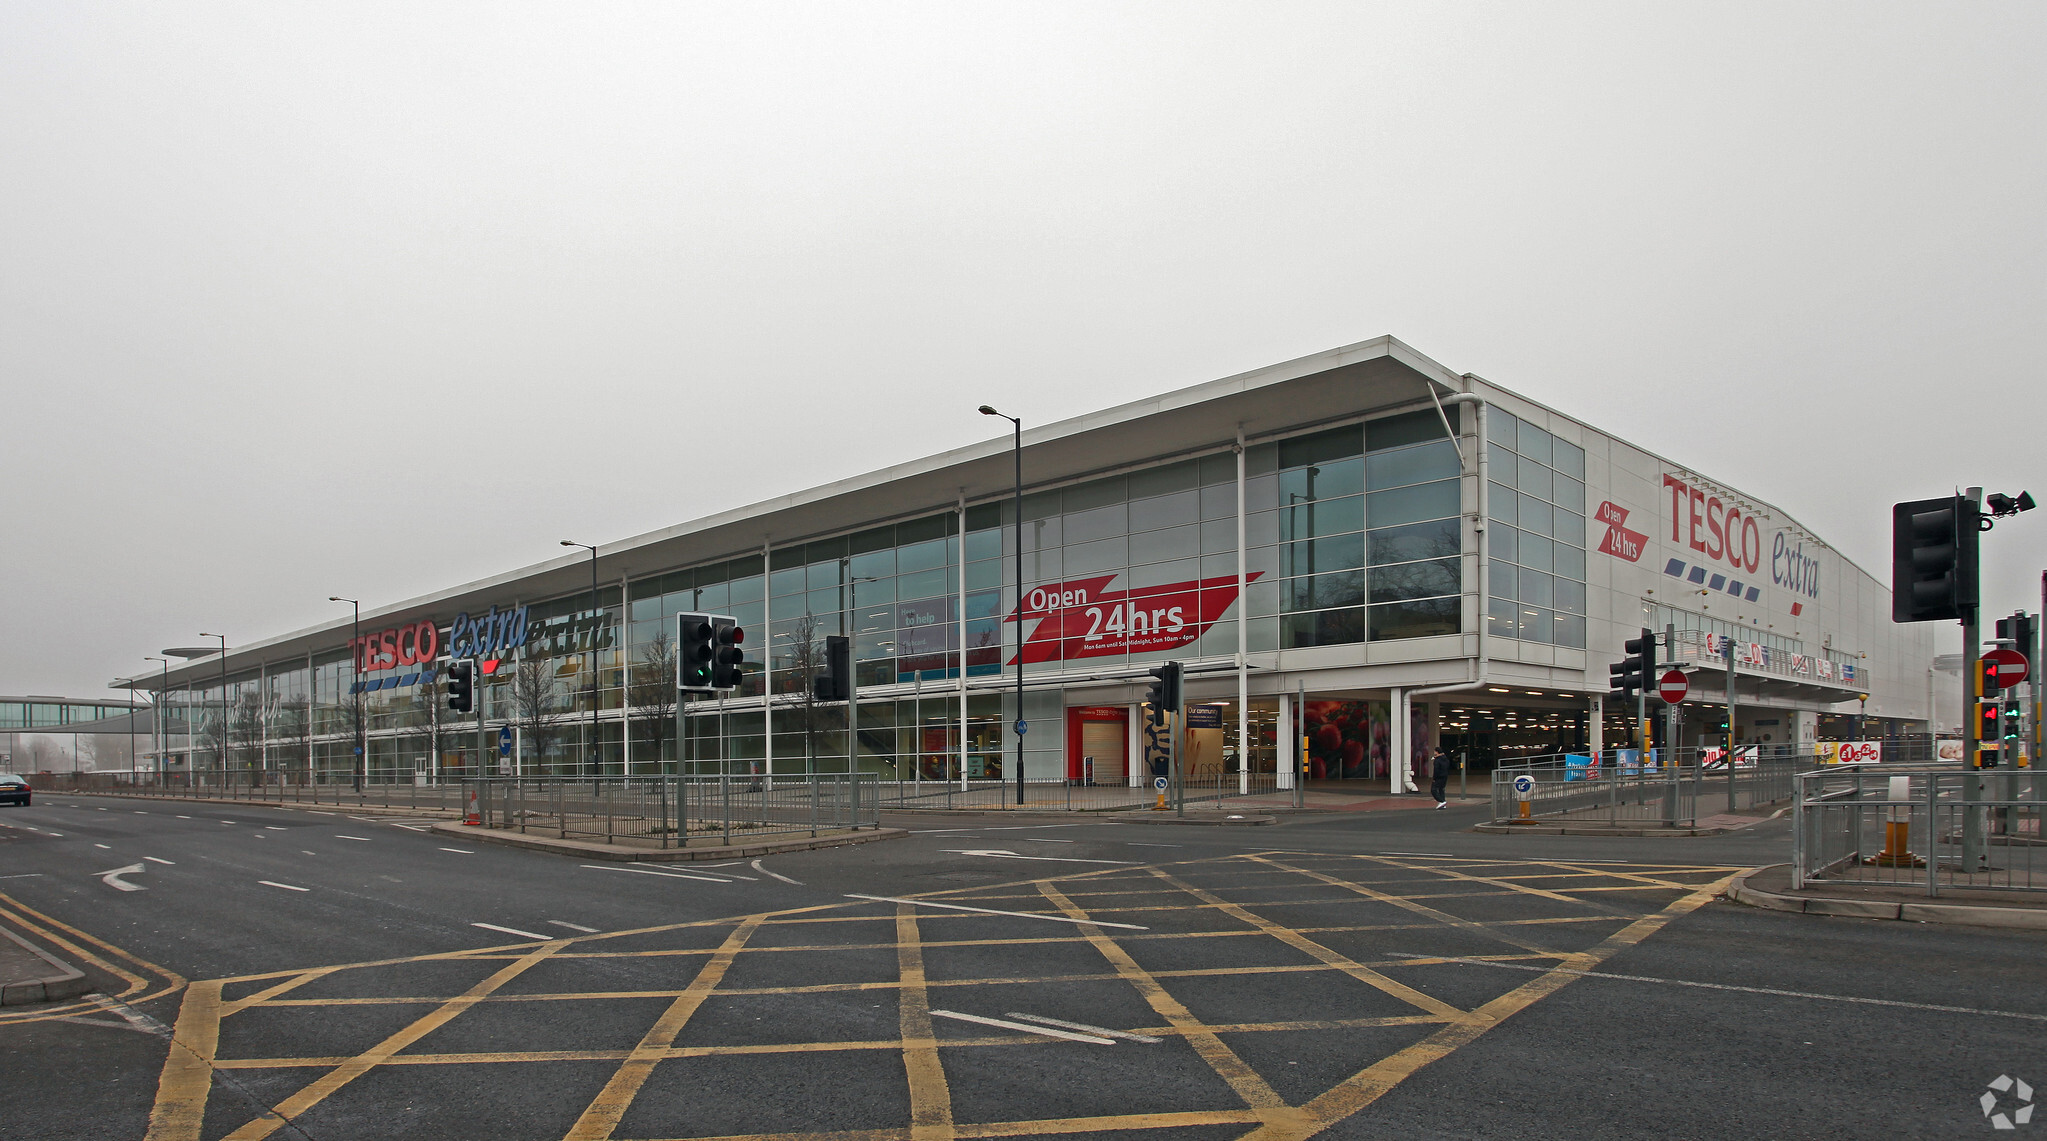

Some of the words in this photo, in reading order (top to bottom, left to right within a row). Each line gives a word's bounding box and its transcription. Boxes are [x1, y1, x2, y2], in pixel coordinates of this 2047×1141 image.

[1604, 503, 1622, 523] Open
[1663, 473, 1760, 574] TESCO
[1772, 531, 1819, 600] extra
[916, 612, 935, 625] help
[1030, 588, 1087, 614] Open
[1084, 602, 1184, 642] 24hrs
[347, 619, 439, 675] TESCO
[450, 605, 529, 659] extra
